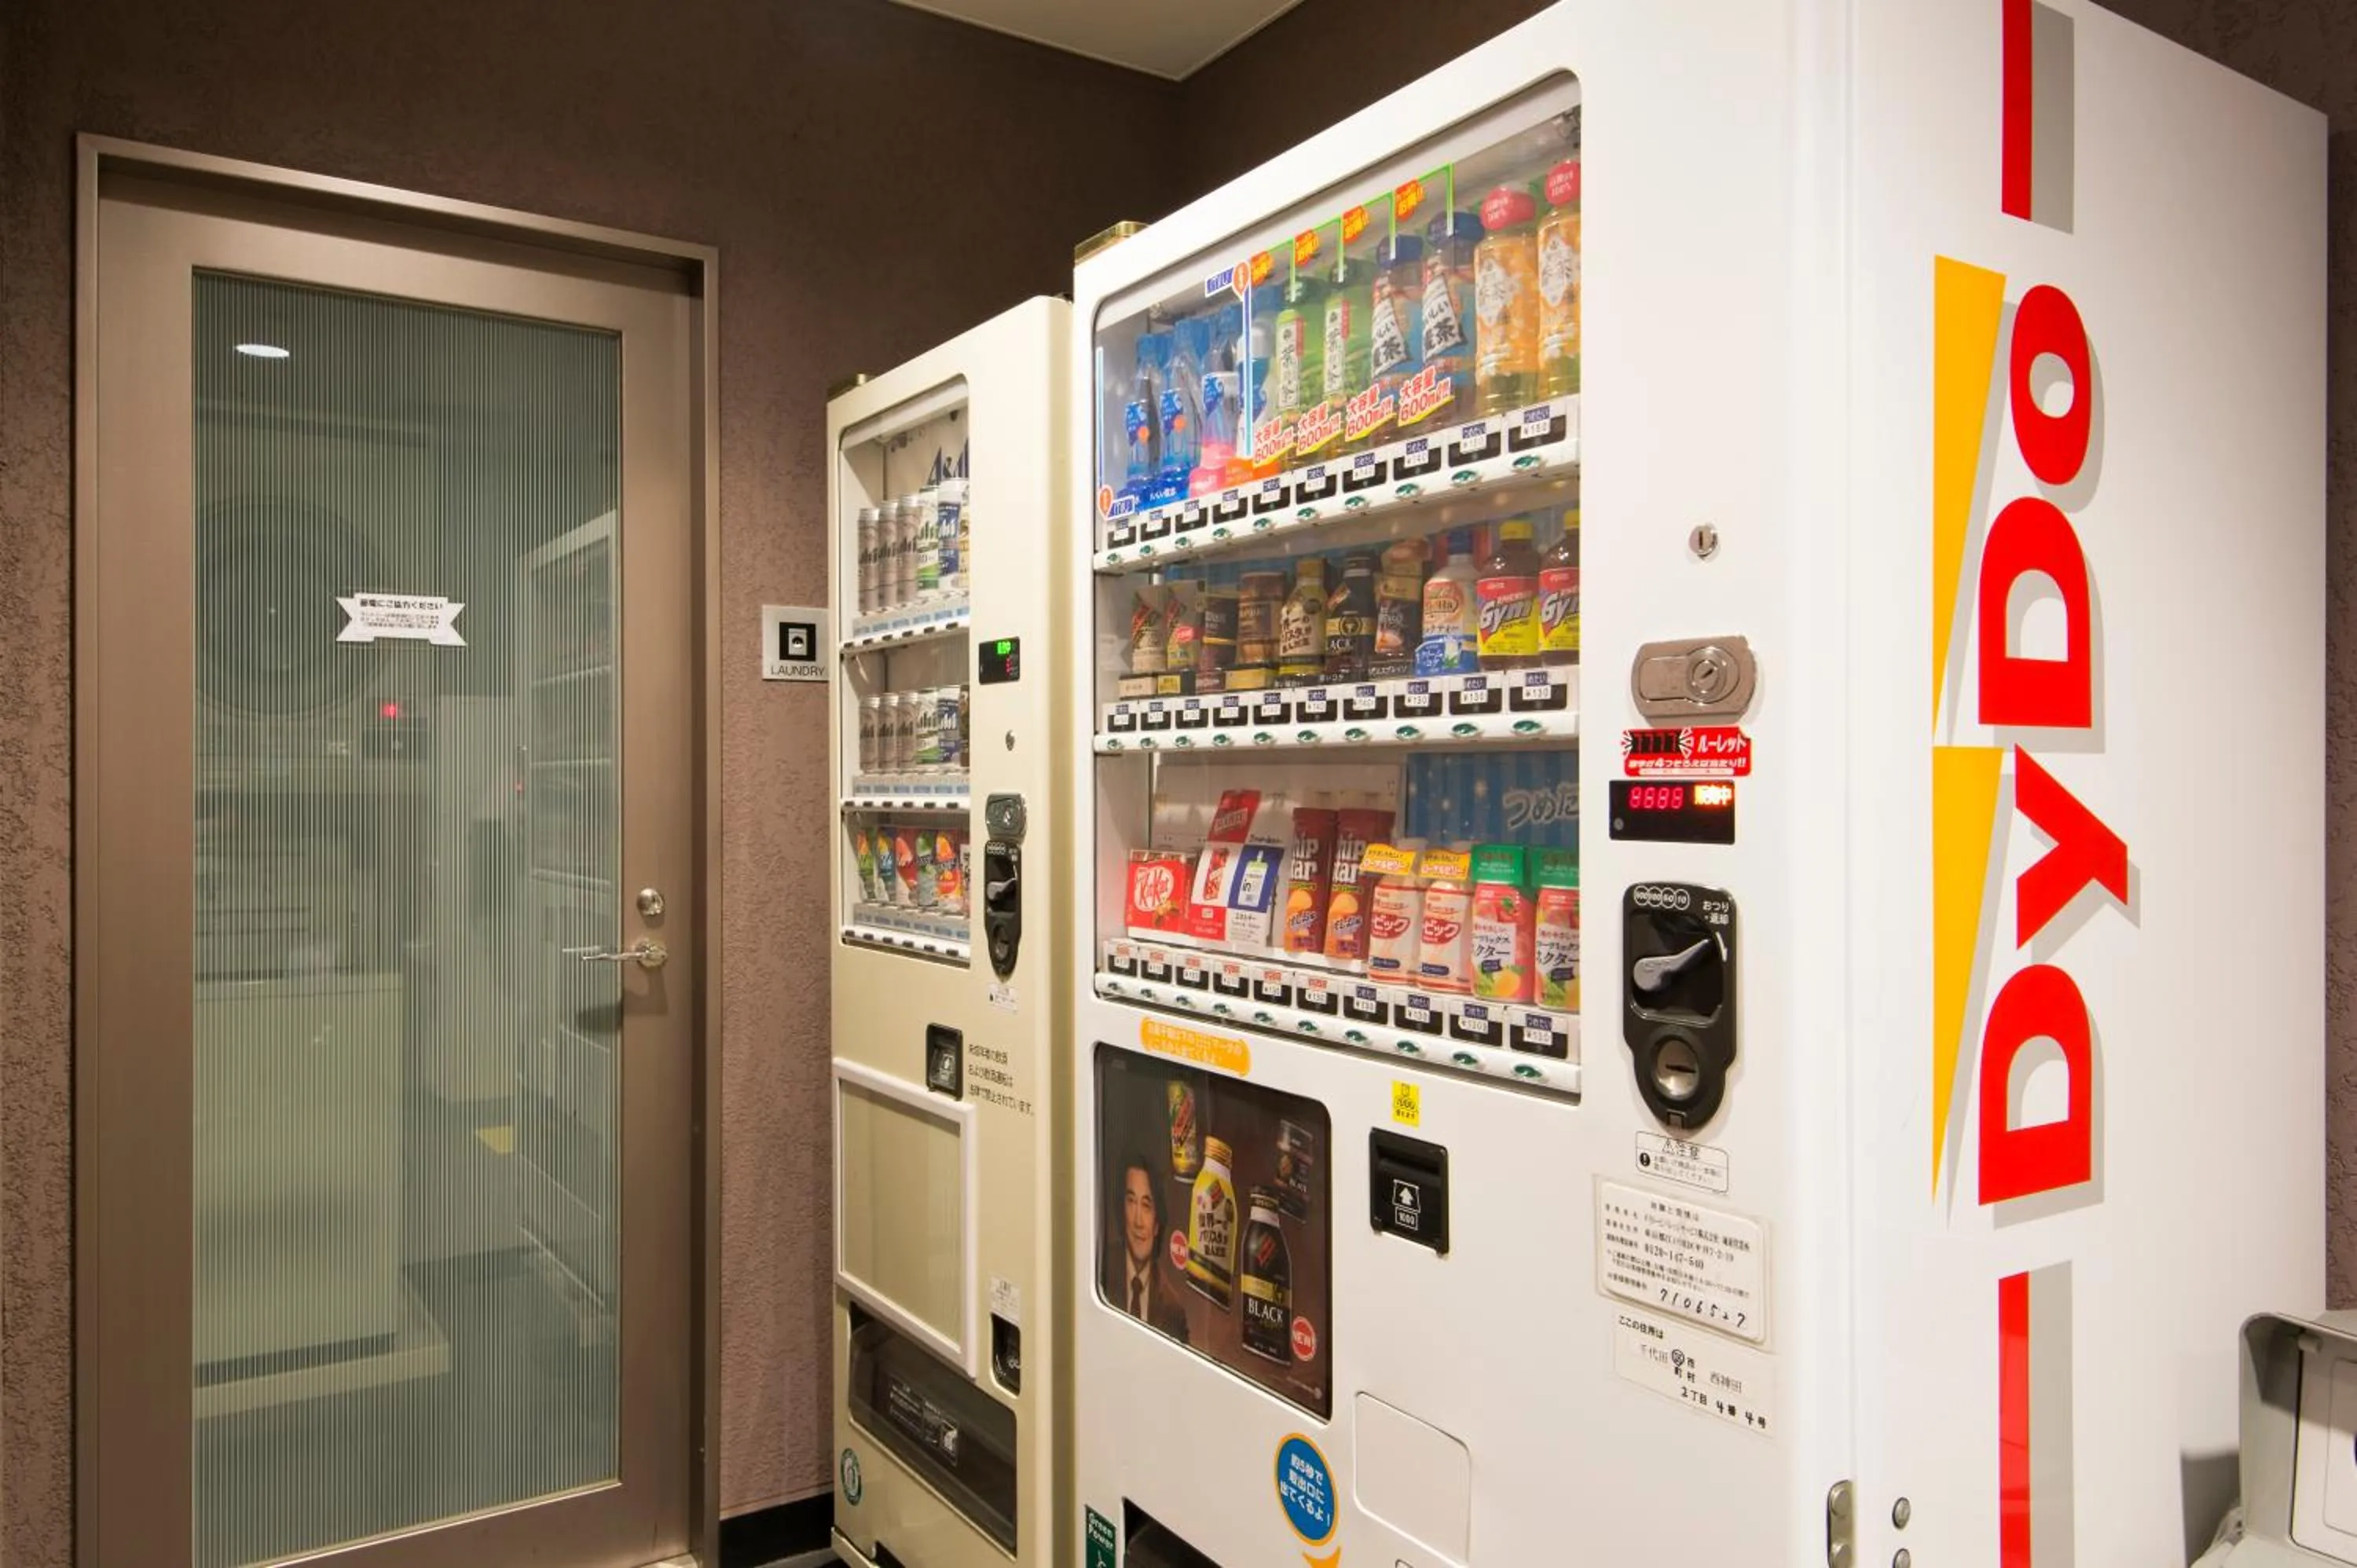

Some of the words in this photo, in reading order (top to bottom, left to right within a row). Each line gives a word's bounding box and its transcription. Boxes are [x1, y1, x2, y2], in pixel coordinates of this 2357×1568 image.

[771, 665, 826, 676] LAUNDRY
[1698, 734, 1747, 753] ルーレット
[1703, 900, 1728, 913] おつり
[1248, 1298, 1284, 1324] BLACK
[1293, 1331, 1314, 1346] NEW
[1291, 1453, 1323, 1486] 約5秒で
[1088, 1513, 1113, 1539] Green
[1088, 1523, 1113, 1551] Power
